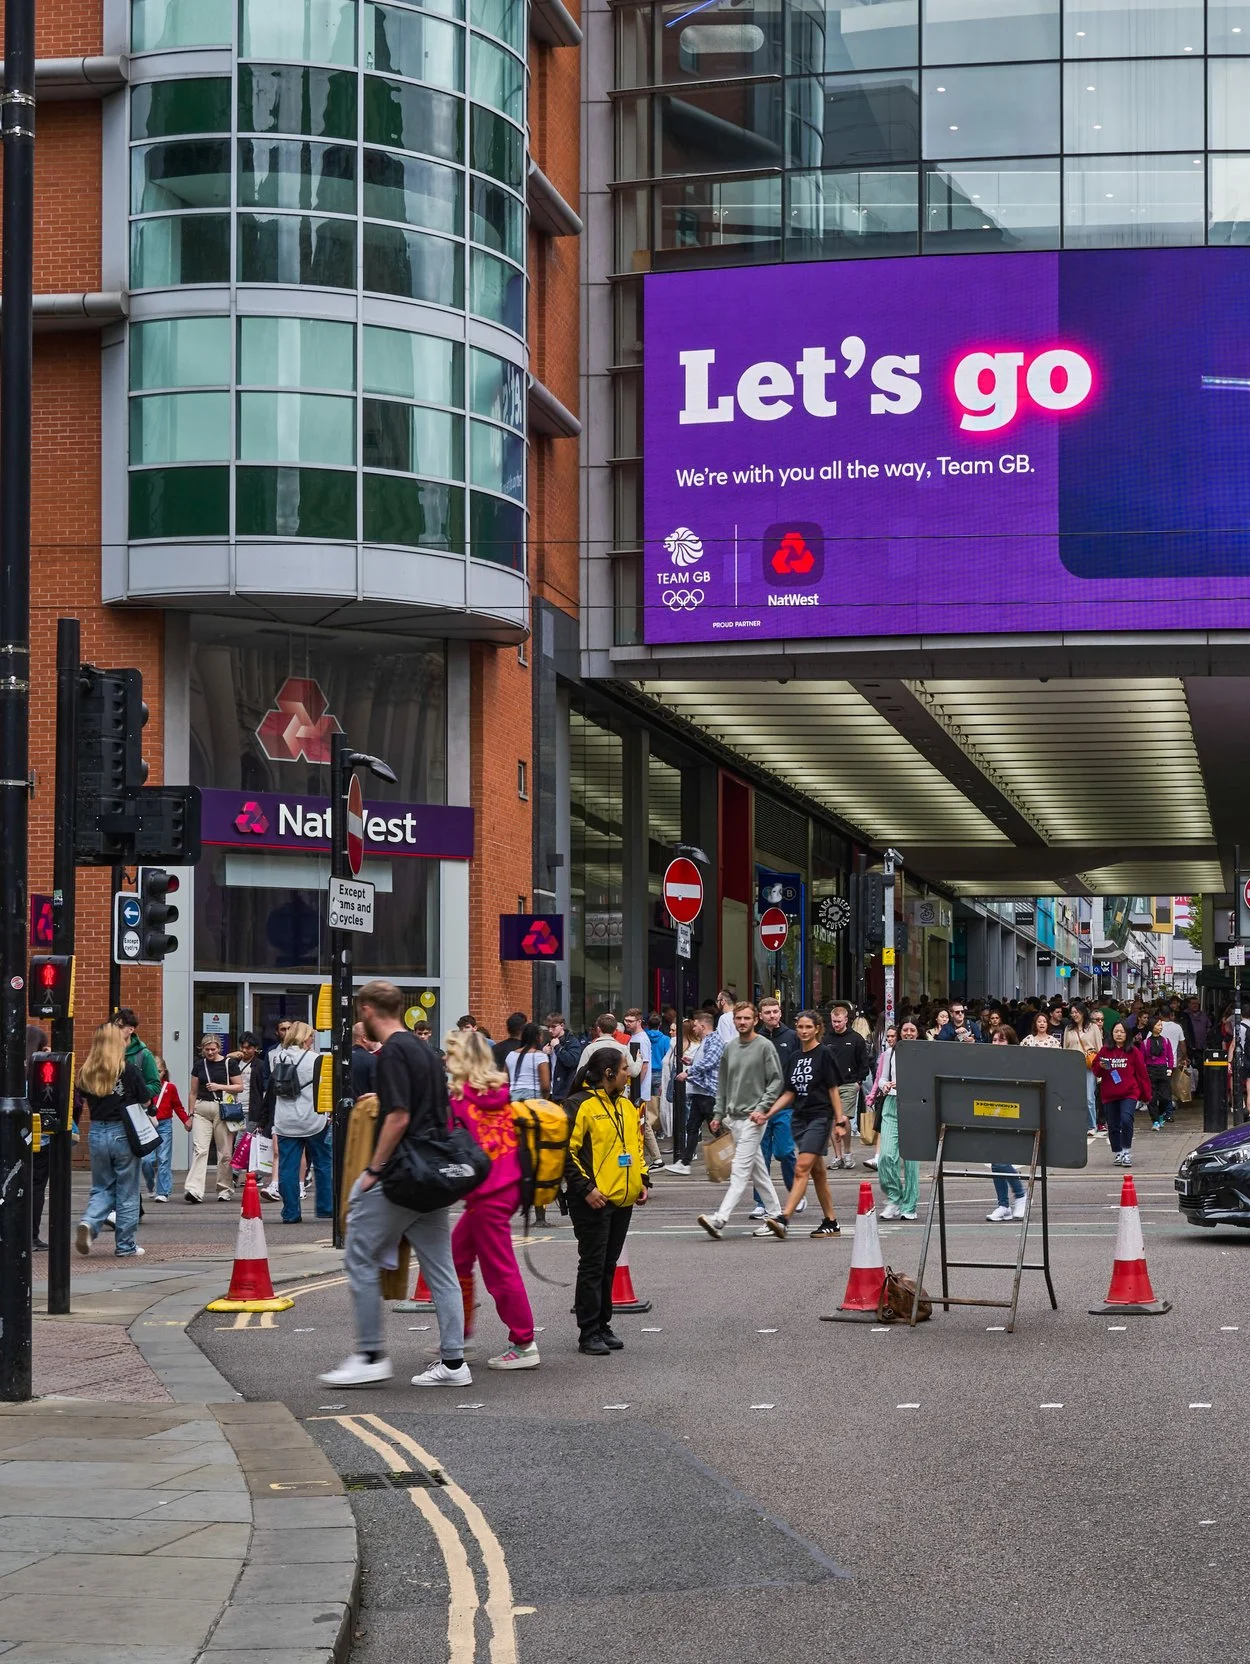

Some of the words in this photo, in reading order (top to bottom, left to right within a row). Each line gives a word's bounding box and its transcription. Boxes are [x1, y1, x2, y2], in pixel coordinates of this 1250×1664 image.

[679, 335, 922, 425] Let's
[953, 349, 1093, 432] go
[675, 467, 728, 487] We're
[732, 464, 774, 484] with
[778, 466, 815, 487] you
[819, 460, 842, 480] all
[846, 459, 880, 479] the
[884, 461, 932, 482] way,
[936, 456, 994, 475] Team
[998, 454, 1035, 474] GB.
[657, 572, 690, 585] TEAM
[692, 571, 711, 583] GB
[767, 593, 820, 607] NatWest
[712, 621, 734, 629] PROUD
[735, 620, 762, 628] PARTNER
[278, 803, 417, 844] Natest
[339, 883, 366, 900] Except
[356, 903, 372, 914] and
[339, 914, 364, 926] cycles
[796, 1057, 813, 1067] PH
[792, 1066, 813, 1075] ILO
[790, 1074, 814, 1085] SOP
